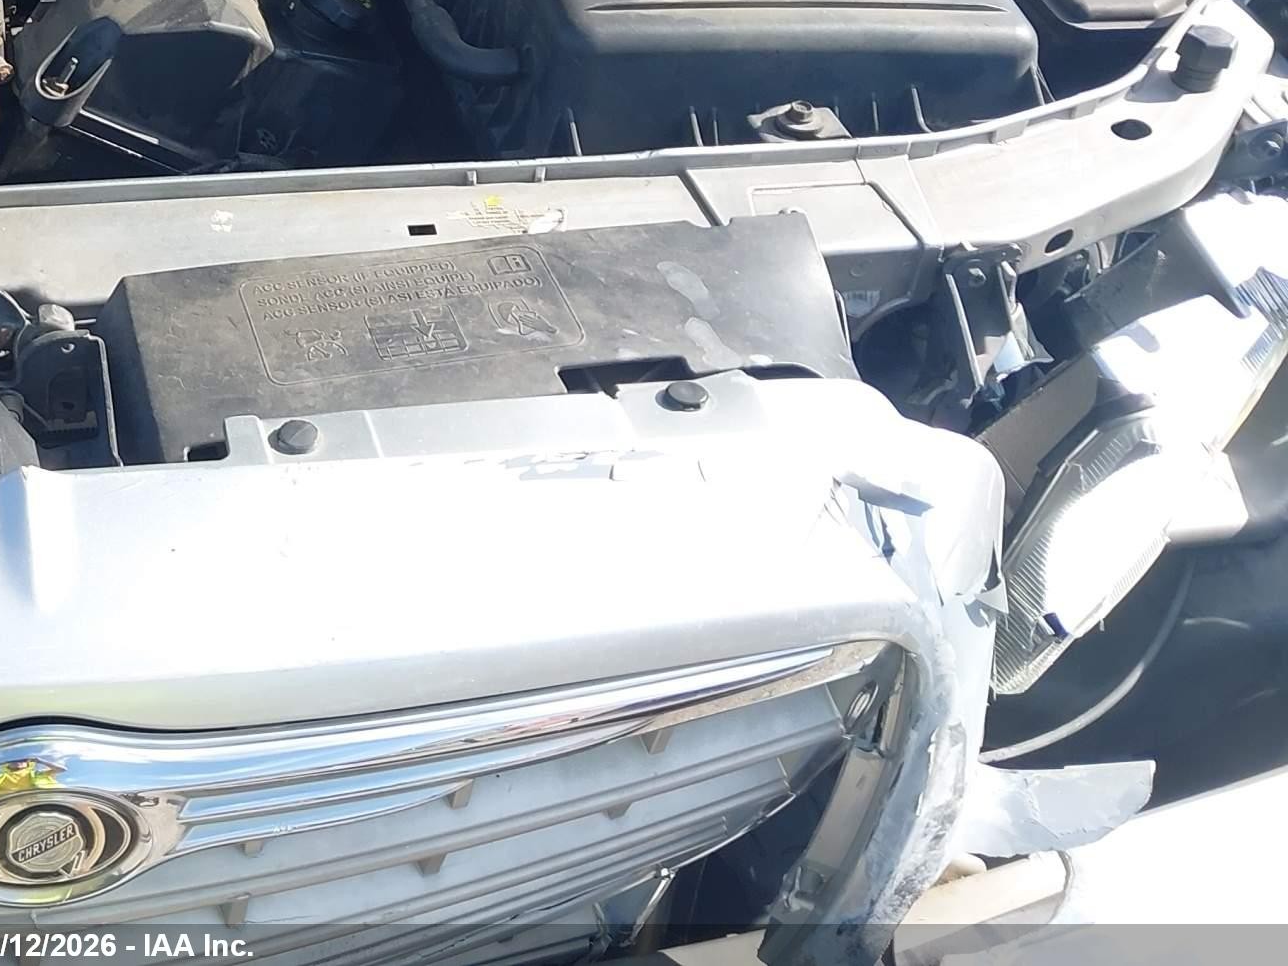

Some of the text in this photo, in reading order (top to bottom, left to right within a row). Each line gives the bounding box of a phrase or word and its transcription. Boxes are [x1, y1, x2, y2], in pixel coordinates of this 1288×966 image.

[253, 281, 285, 295] ACC
[287, 274, 350, 291] SENSOR
[314, 287, 346, 301] ACC
[263, 307, 297, 321] ACC
[298, 298, 361, 315] SENSOR
[17, 823, 75, 862] CHRYSLER
